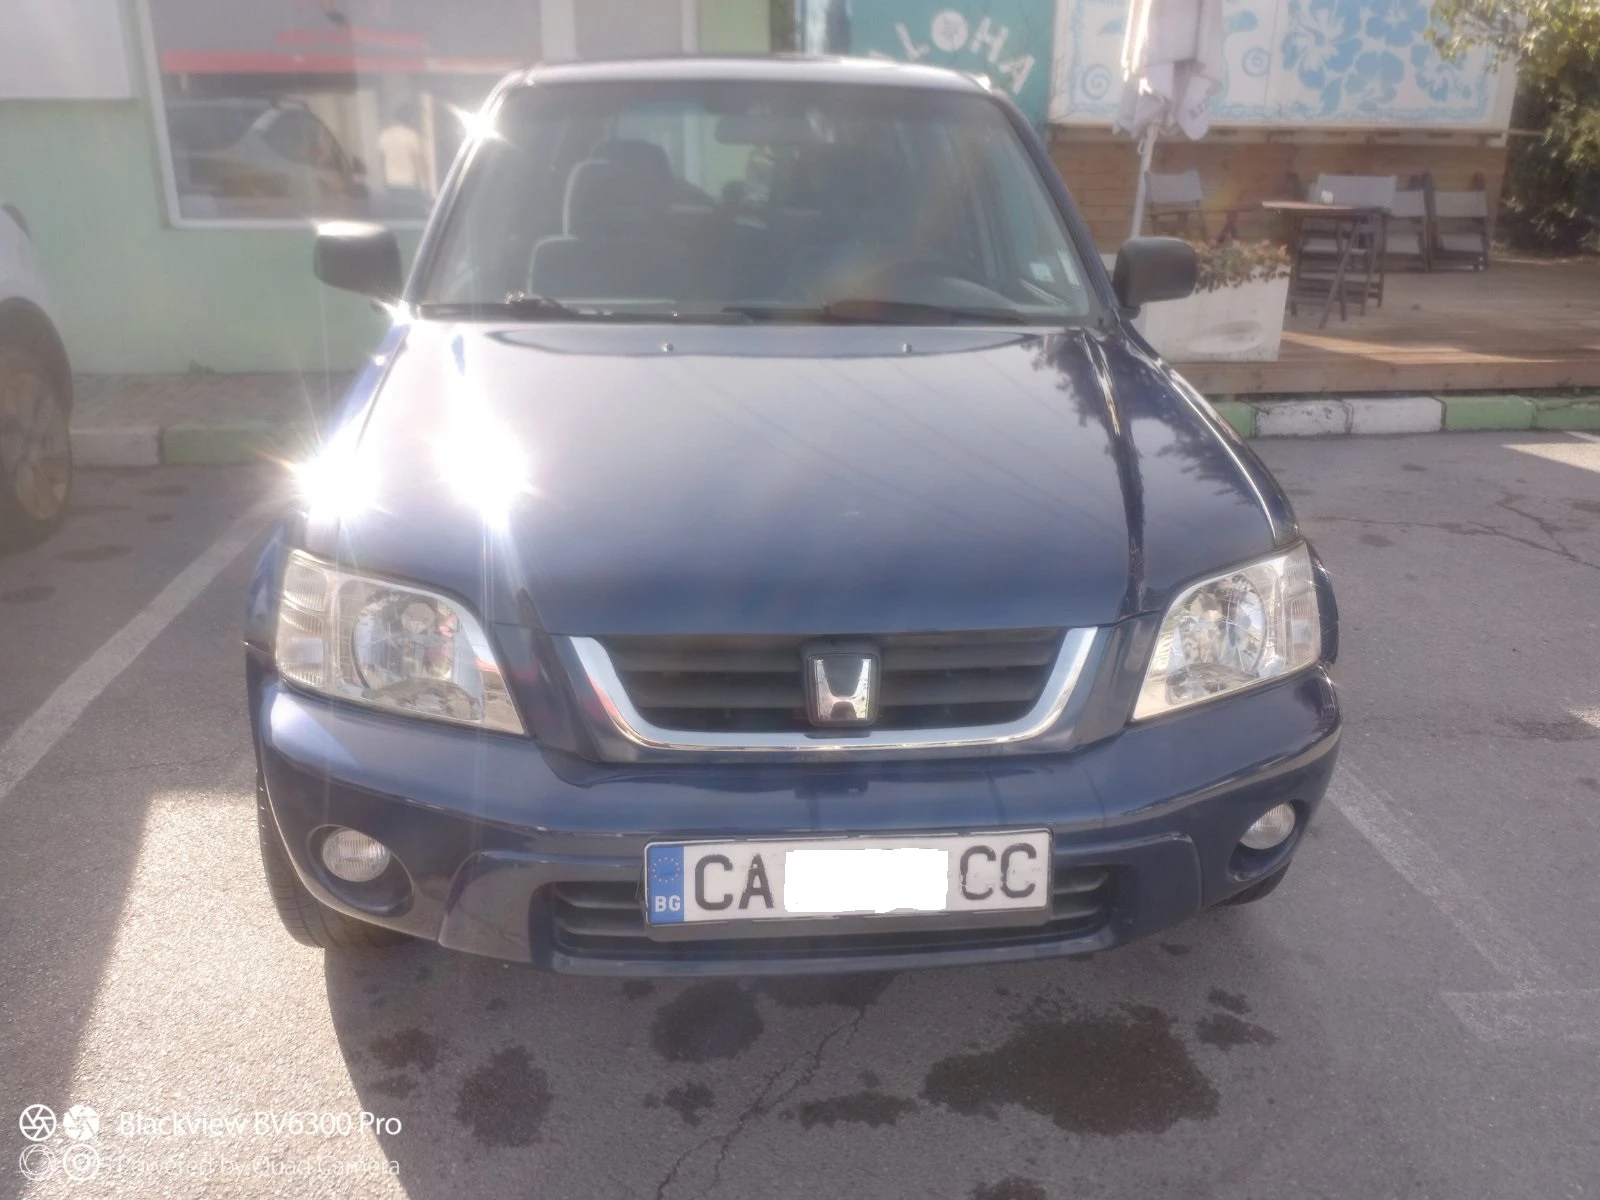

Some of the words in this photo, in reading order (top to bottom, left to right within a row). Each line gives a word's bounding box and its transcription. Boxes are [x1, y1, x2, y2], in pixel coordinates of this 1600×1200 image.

[868, 9, 1036, 95] LOHA
[654, 894, 681, 913] BG
[694, 854, 775, 911] CA
[959, 842, 1038, 901] CC
